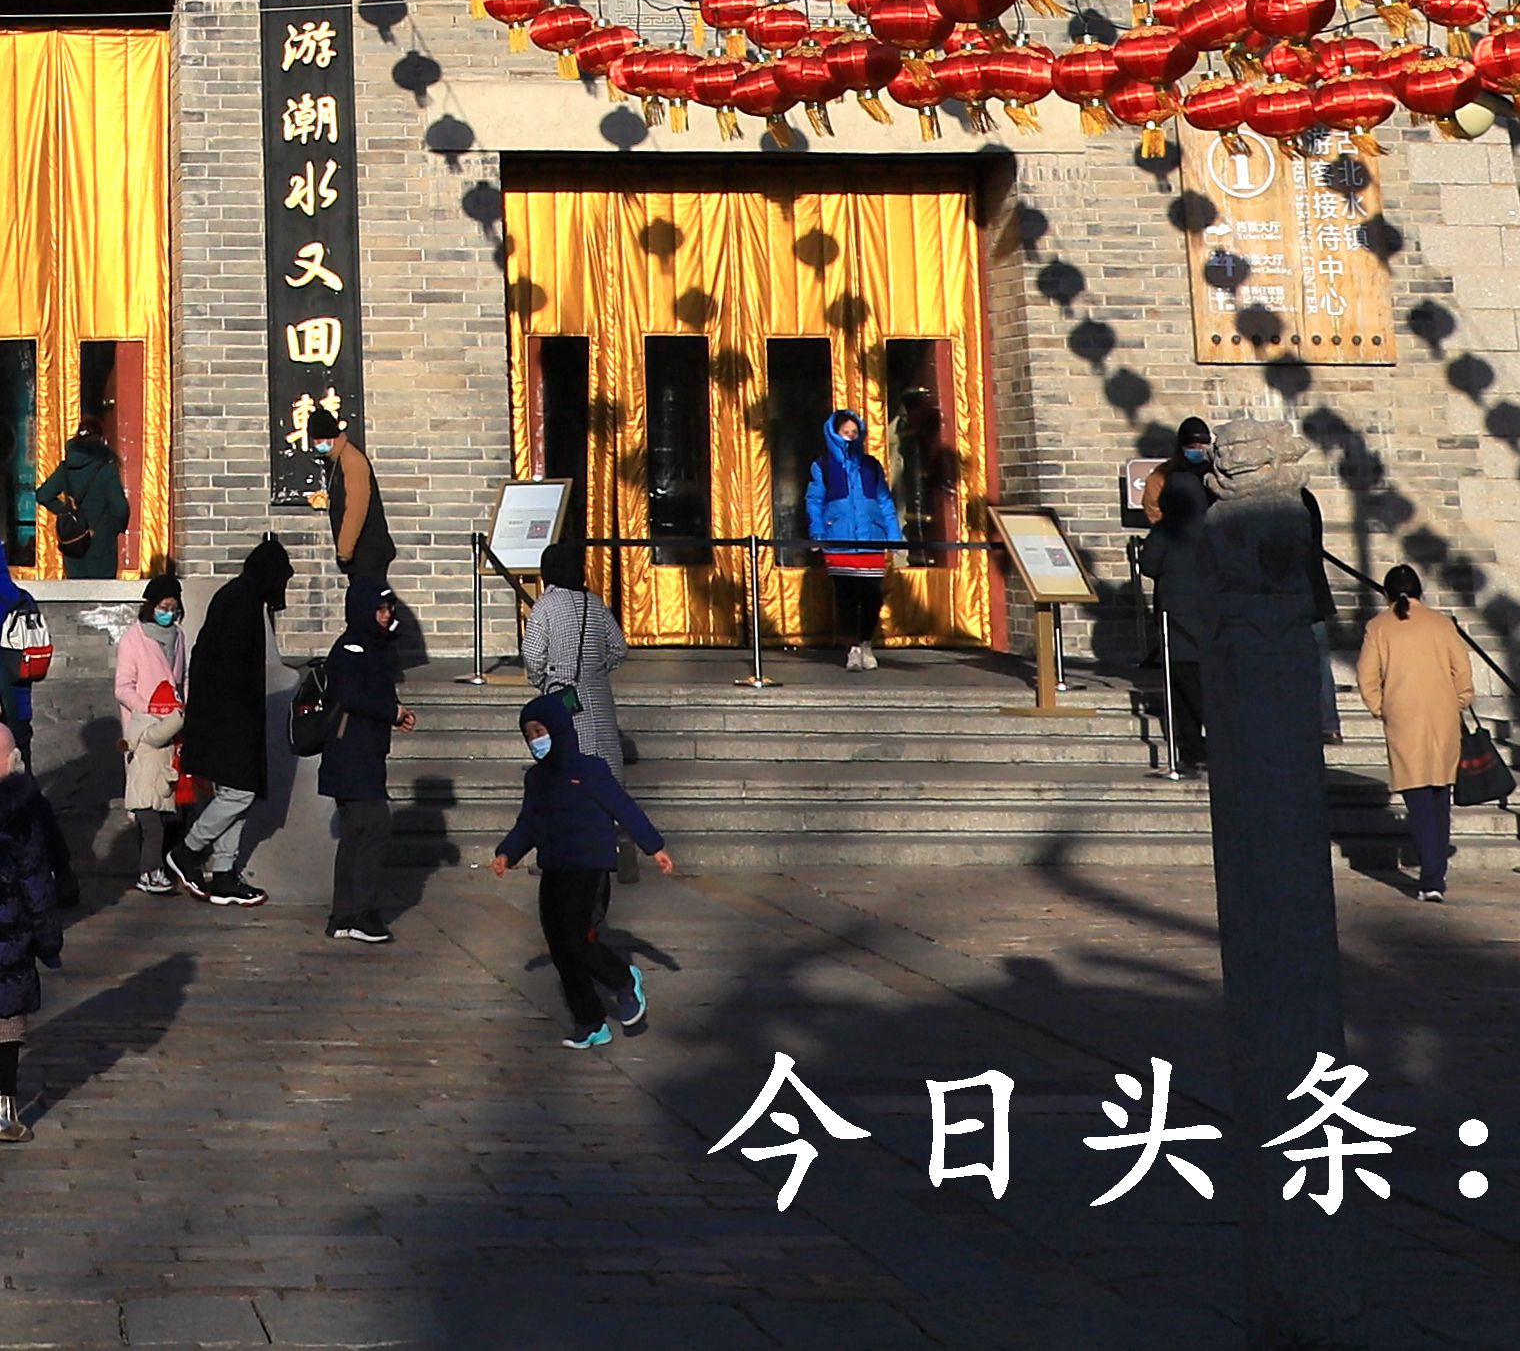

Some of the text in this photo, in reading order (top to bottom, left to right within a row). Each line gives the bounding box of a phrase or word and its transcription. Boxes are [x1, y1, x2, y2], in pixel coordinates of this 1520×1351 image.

[1307, 127, 1348, 316] 游客接待中心
